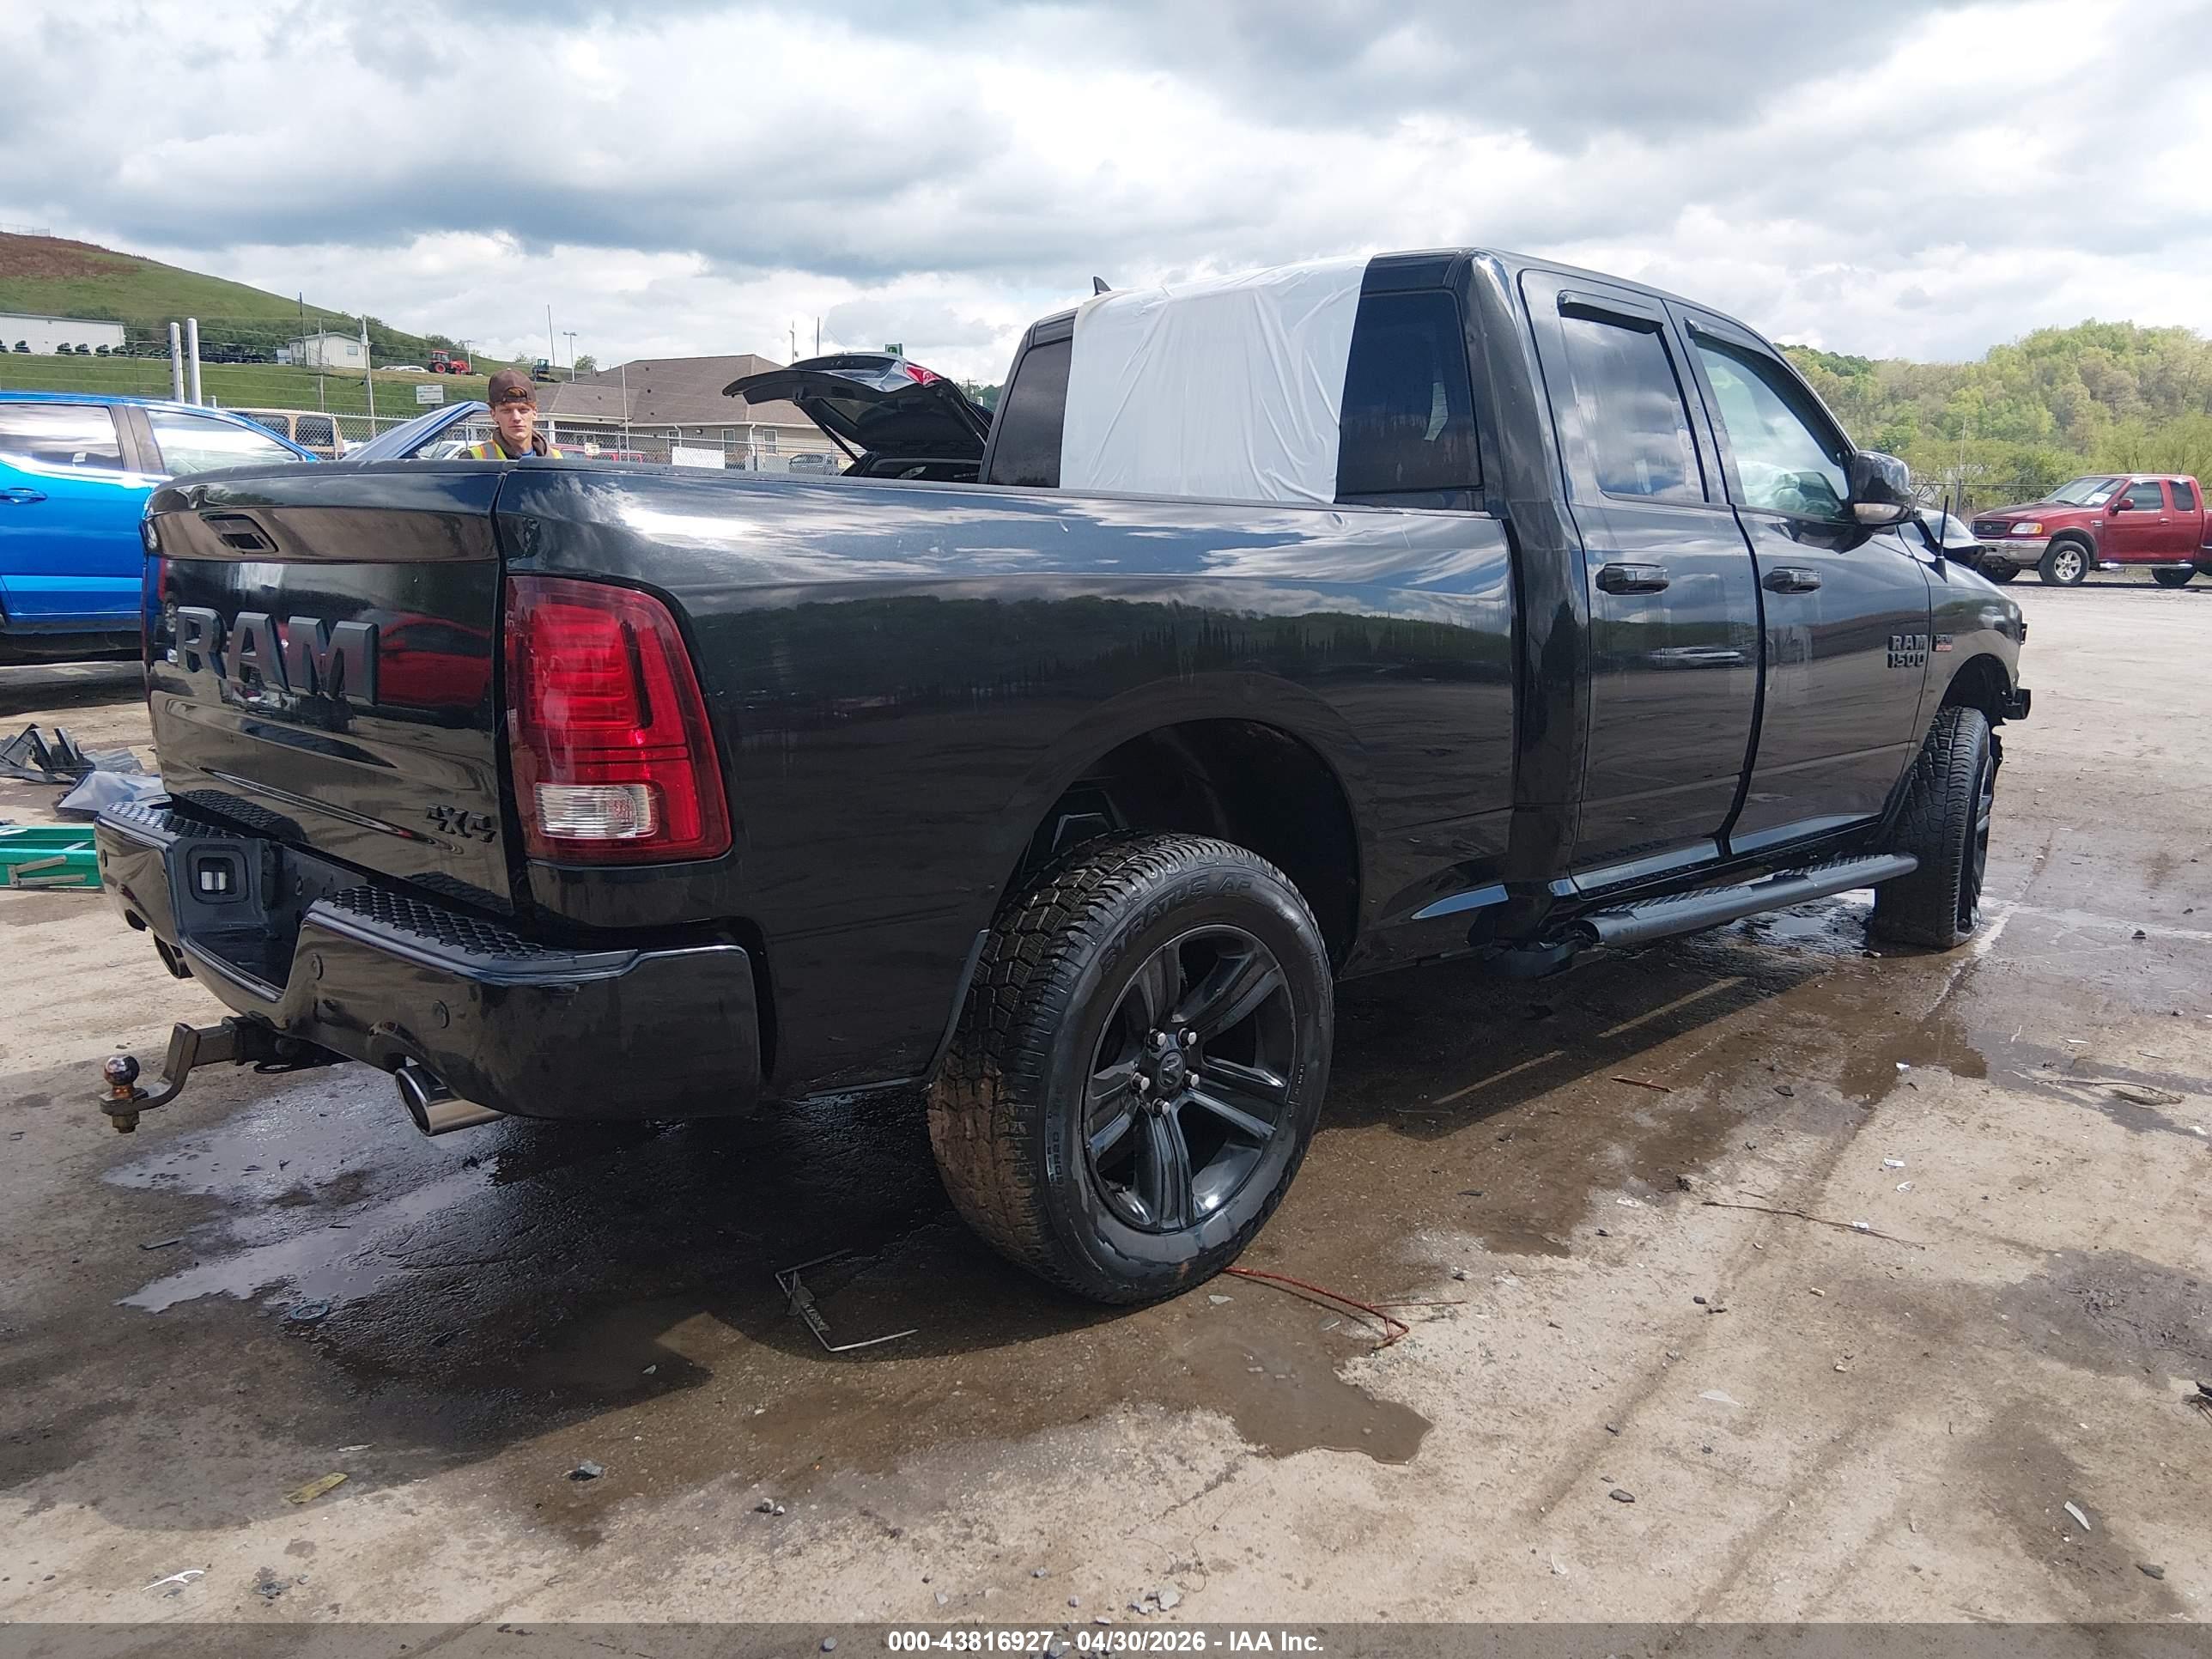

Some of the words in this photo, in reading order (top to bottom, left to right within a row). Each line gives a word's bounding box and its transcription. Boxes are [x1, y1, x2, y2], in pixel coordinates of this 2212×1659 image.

[1889, 635, 1929, 651] RAM
[175, 606, 379, 707] RAM
[1887, 653, 1924, 668] 1500
